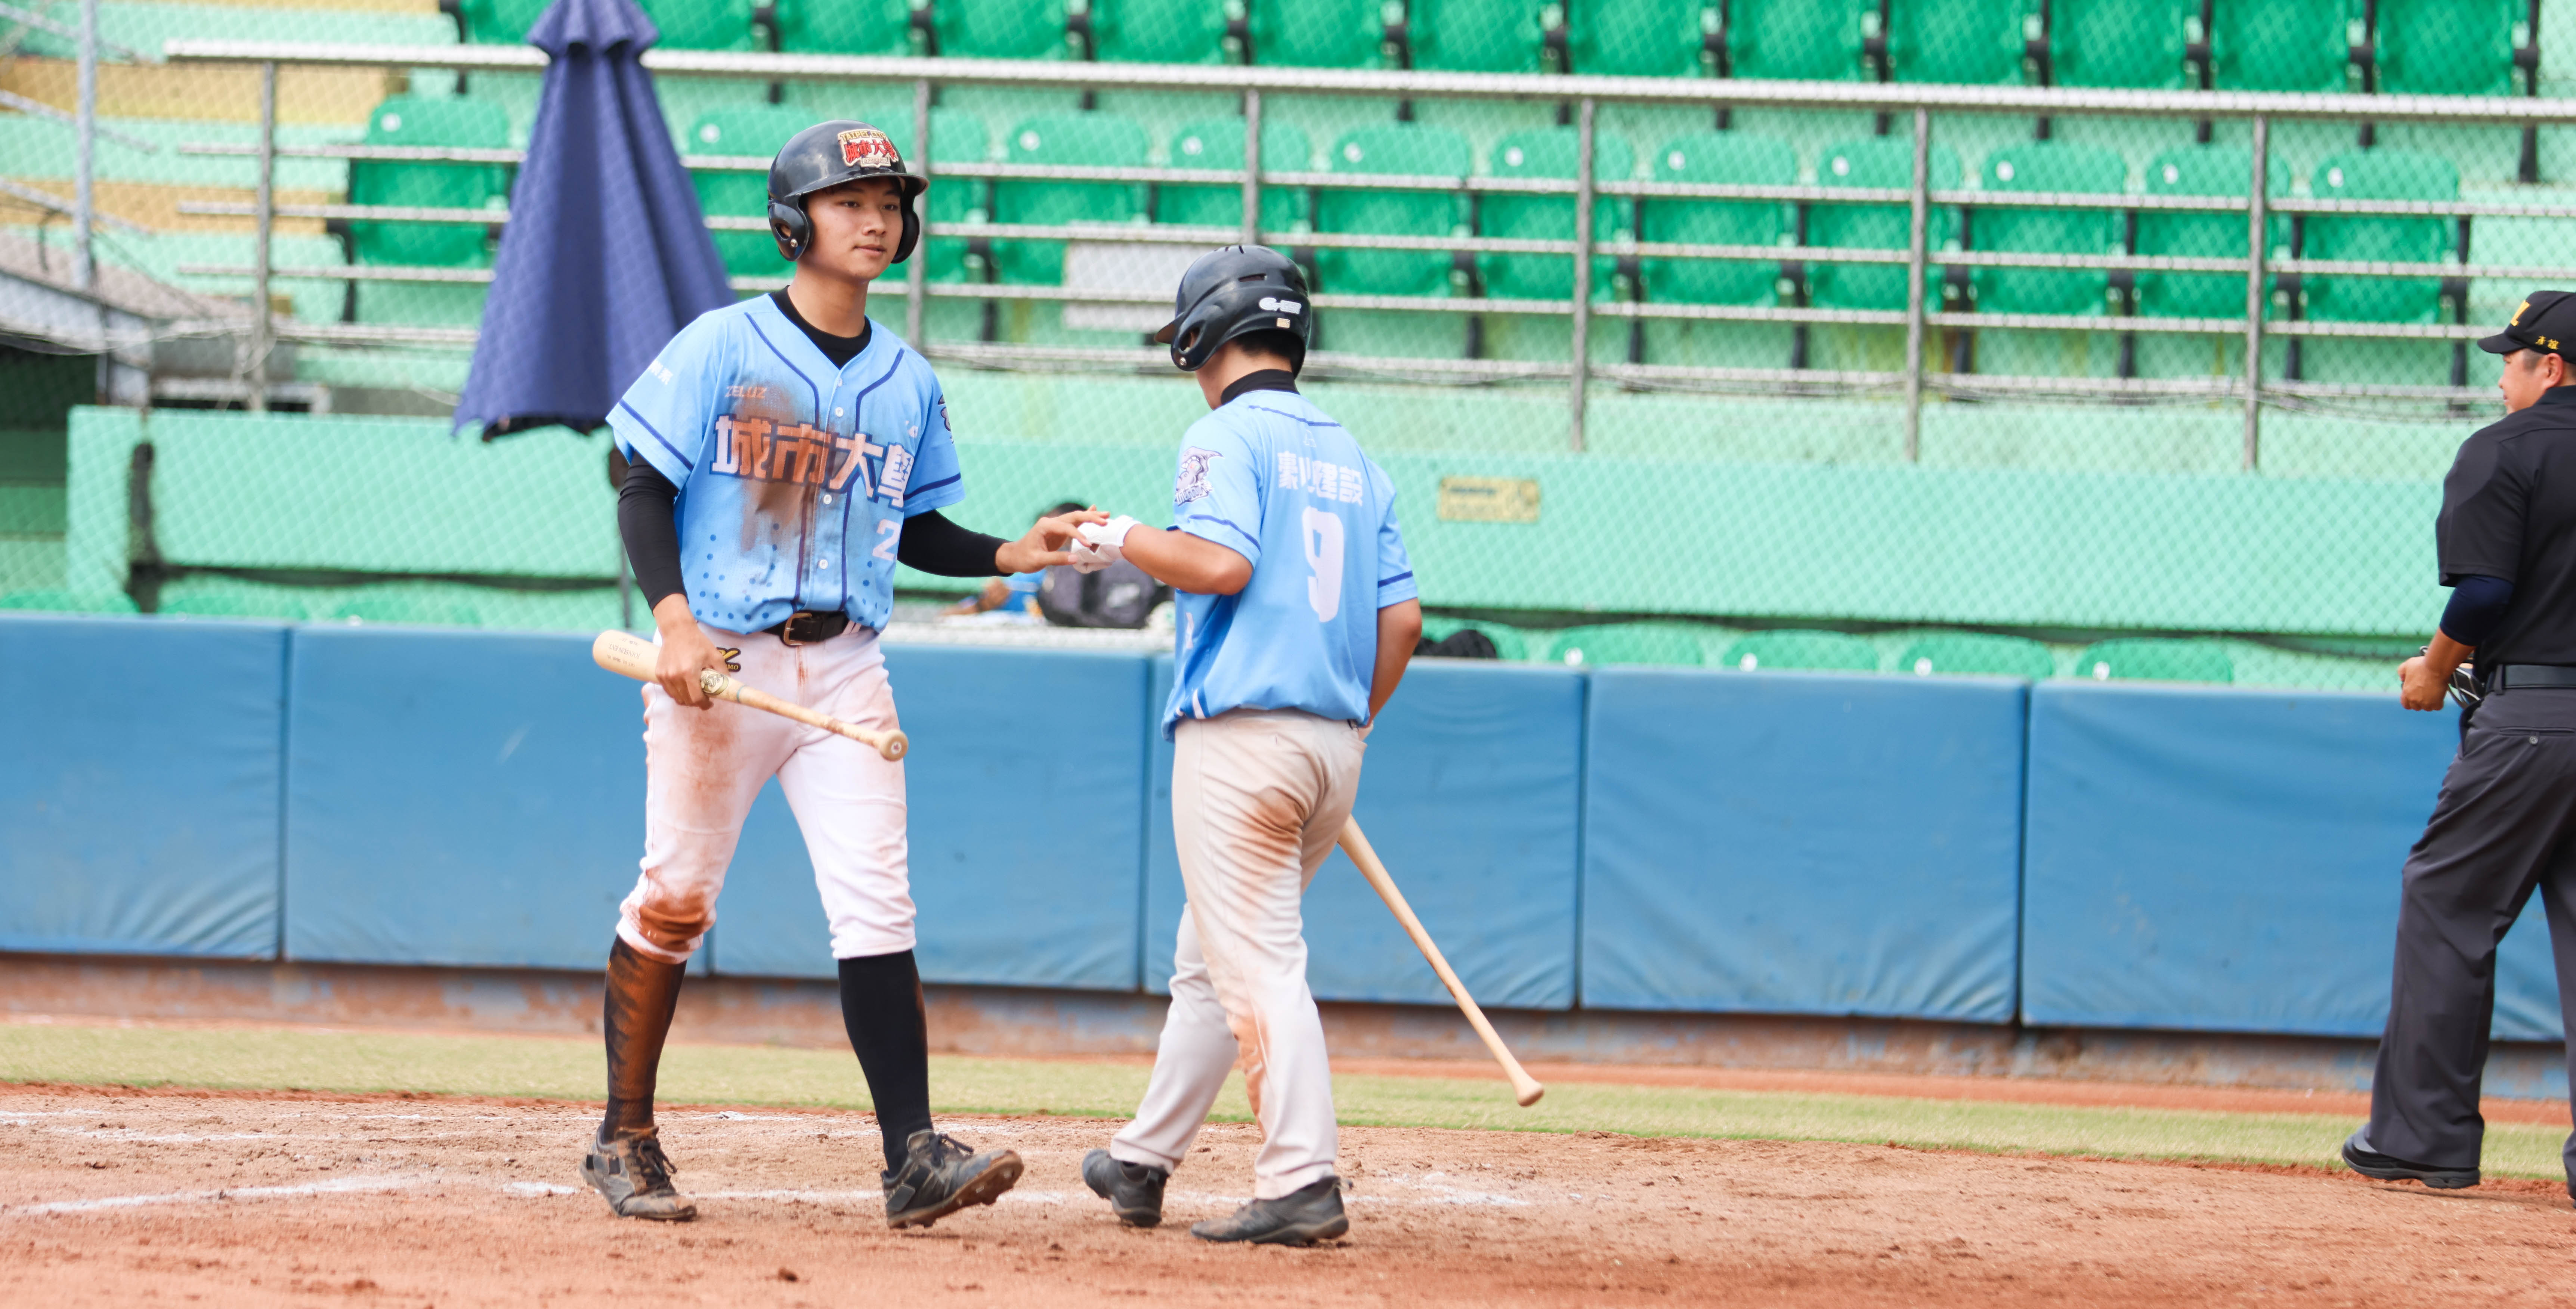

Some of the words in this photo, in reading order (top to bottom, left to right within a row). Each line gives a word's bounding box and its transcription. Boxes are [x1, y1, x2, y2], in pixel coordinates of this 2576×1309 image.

[841, 131, 869, 141] TAIPEI
[844, 139, 896, 163] 城市大學
[725, 385, 768, 399] ZELUZ
[711, 415, 915, 509] 城市大學
[872, 518, 901, 561] 2
[1302, 505, 1344, 623] 9
